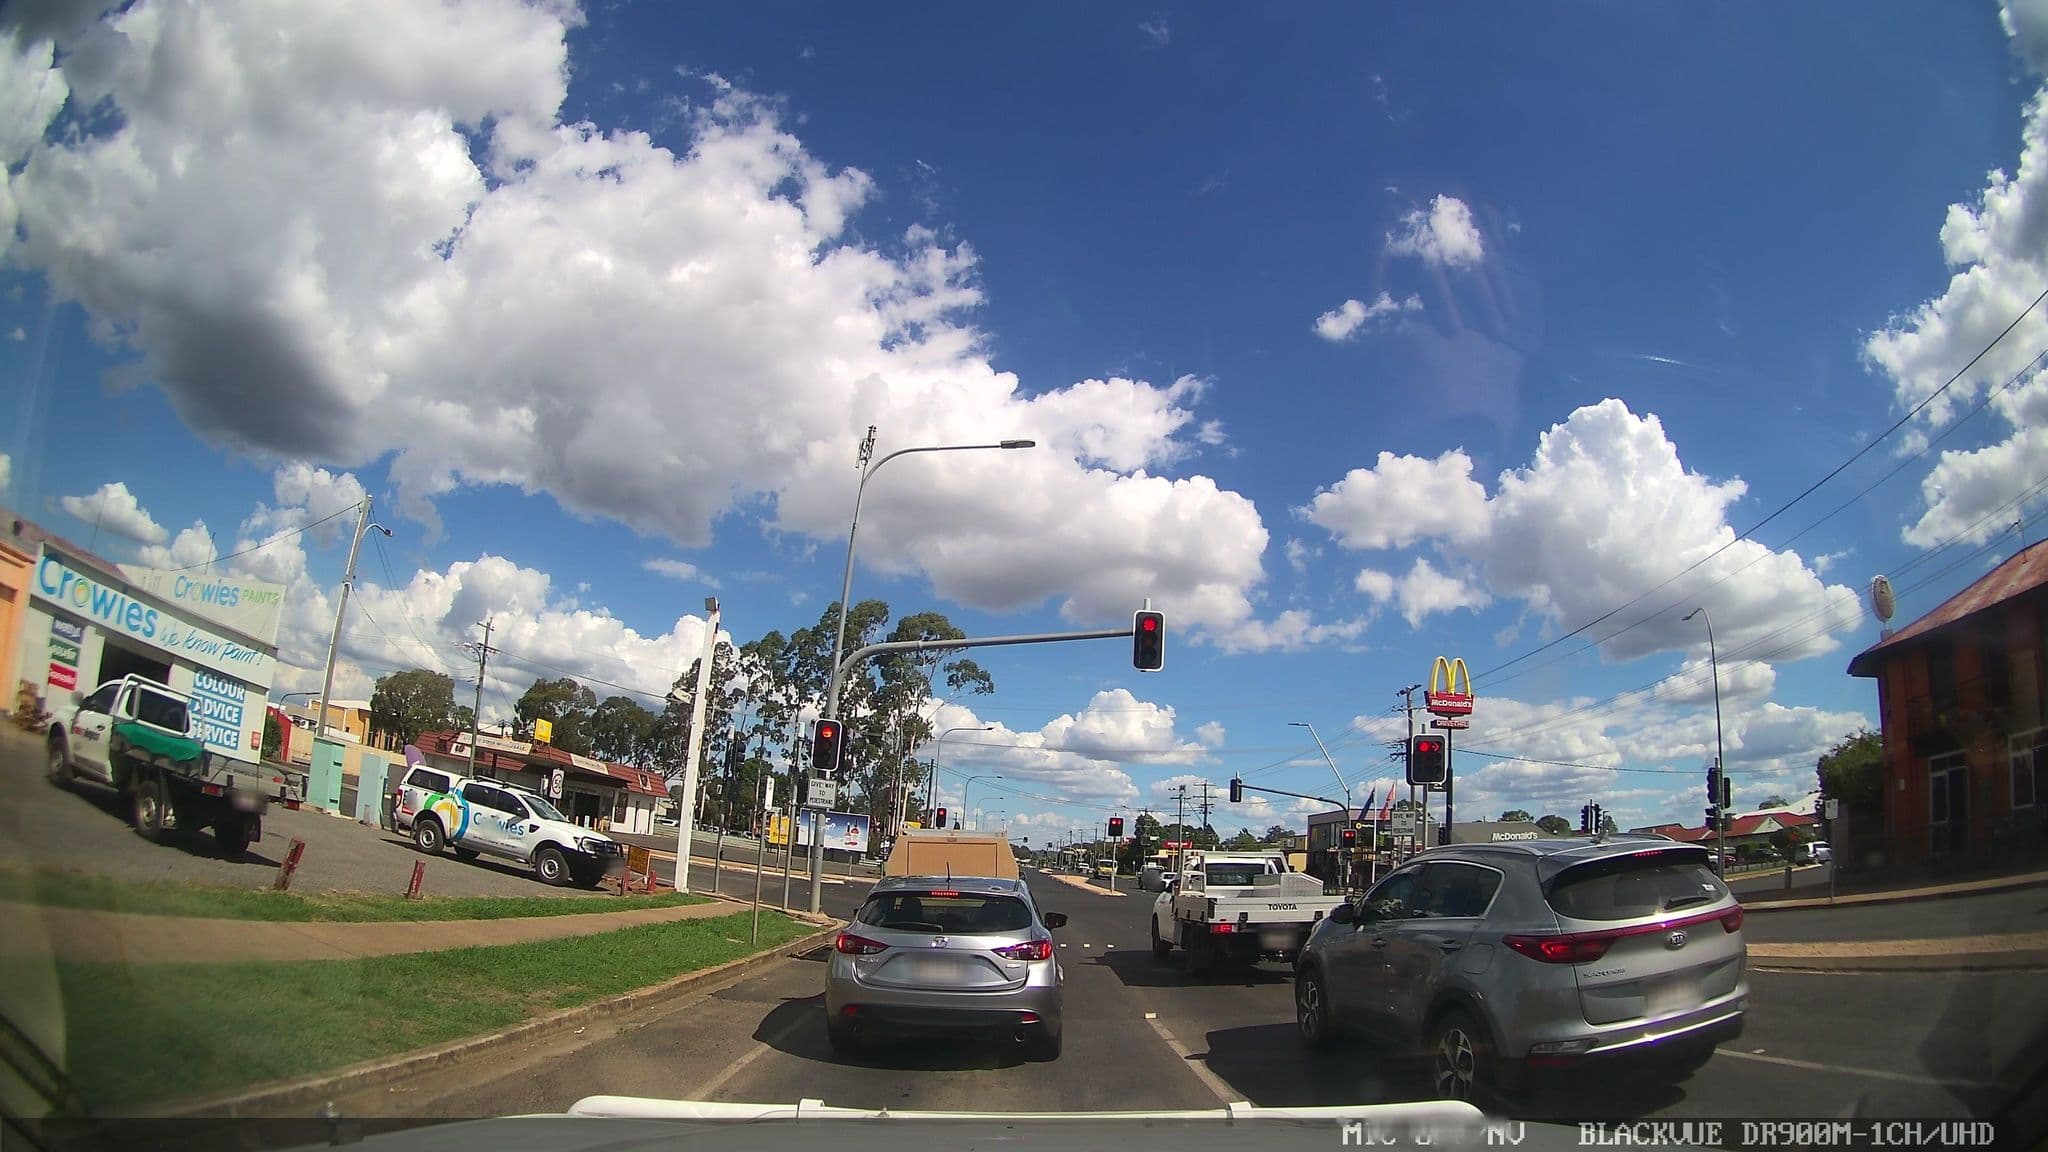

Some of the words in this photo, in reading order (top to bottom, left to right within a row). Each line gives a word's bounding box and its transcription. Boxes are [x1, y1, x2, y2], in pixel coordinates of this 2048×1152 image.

[174, 575, 240, 607] Crowies
[241, 589, 280, 605] PAINTS
[39, 554, 158, 638] Crowies
[183, 629, 223, 656] know
[195, 670, 245, 701] COLOUR
[193, 696, 240, 723] ADVICE
[1431, 699, 1472, 708] McDonald's
[191, 720, 238, 748] SERVICE
[474, 812, 524, 836] Cwies
[1491, 832, 1538, 841] McDonald's
[1267, 903, 1298, 911] TOYOTA
